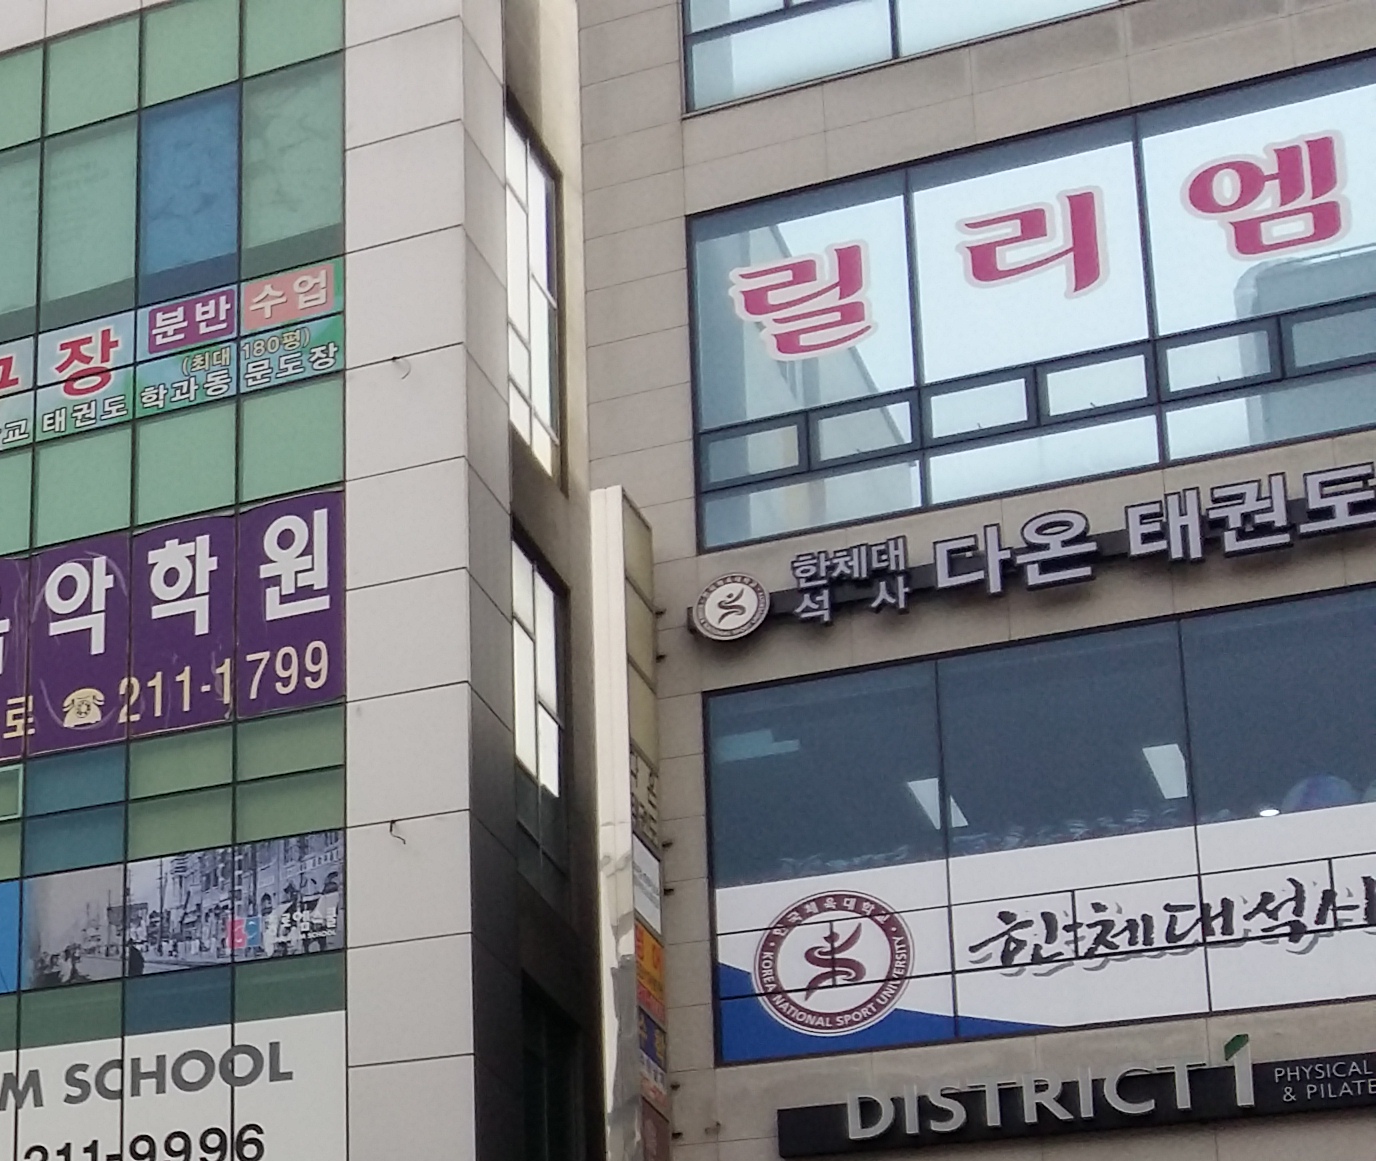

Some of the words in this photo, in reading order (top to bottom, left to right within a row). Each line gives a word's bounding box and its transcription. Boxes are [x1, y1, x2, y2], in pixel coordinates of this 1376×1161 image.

[730, 130, 1347, 361] 릴리엠
[151, 296, 232, 346] 분반
[248, 271, 328, 318] 수업
[934, 510, 1098, 594] 다온
[1125, 462, 1376, 561] 태권도
[793, 536, 907, 588] 한체대
[795, 575, 909, 624] 석사
[119, 641, 328, 724] 211-1799
[760, 950, 777, 993] KOREA
[878, 934, 909, 1005] UNIVERSITY
[772, 993, 833, 1028] NATIONAL
[835, 1003, 878, 1028] SPORT
[63, 1041, 293, 1104] SCHOOL
[847, 1062, 1206, 1140] DISTRICT
[1274, 1060, 1372, 1084] PHYSICAL
[1282, 1087, 1296, 1102] &
